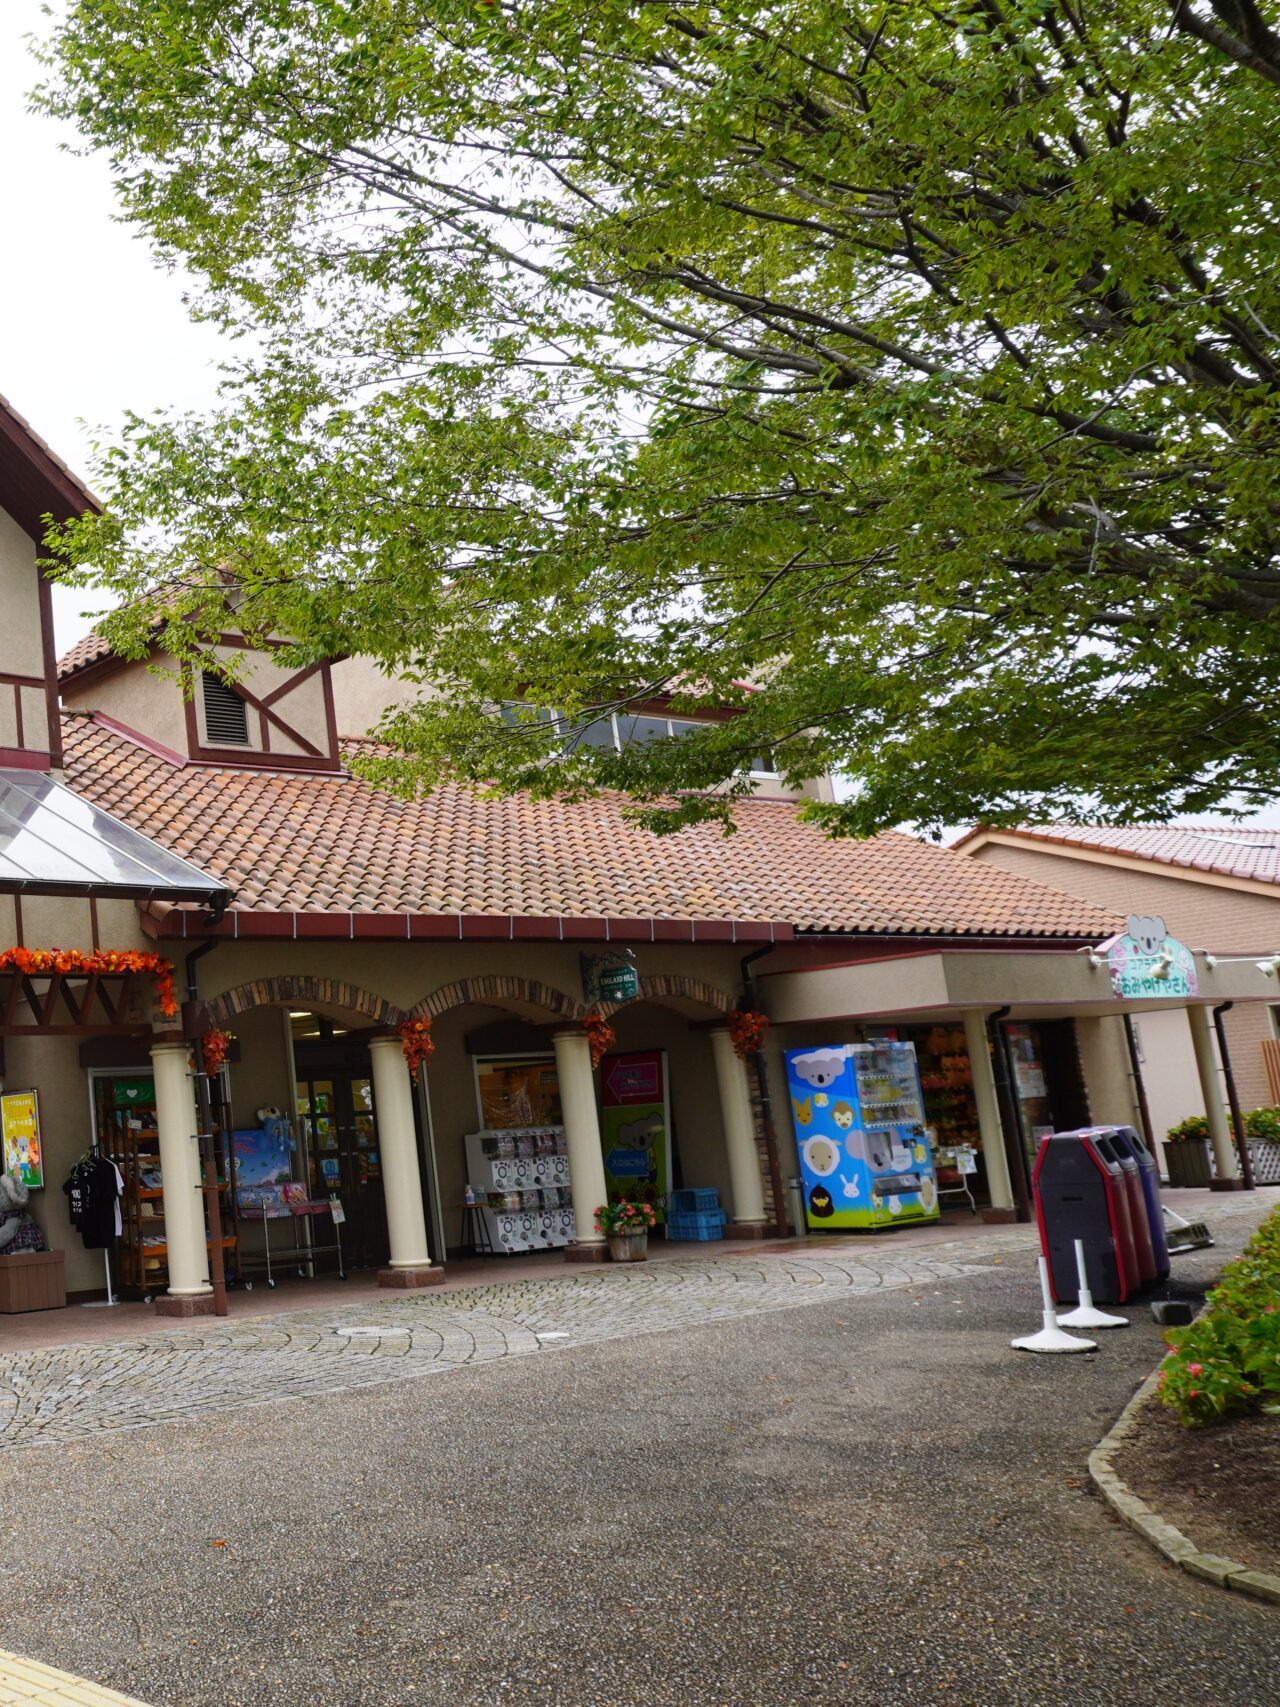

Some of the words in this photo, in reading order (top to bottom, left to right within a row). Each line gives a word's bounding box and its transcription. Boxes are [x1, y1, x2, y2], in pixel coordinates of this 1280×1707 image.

[1121, 976, 1190, 994] おみやげやさん
